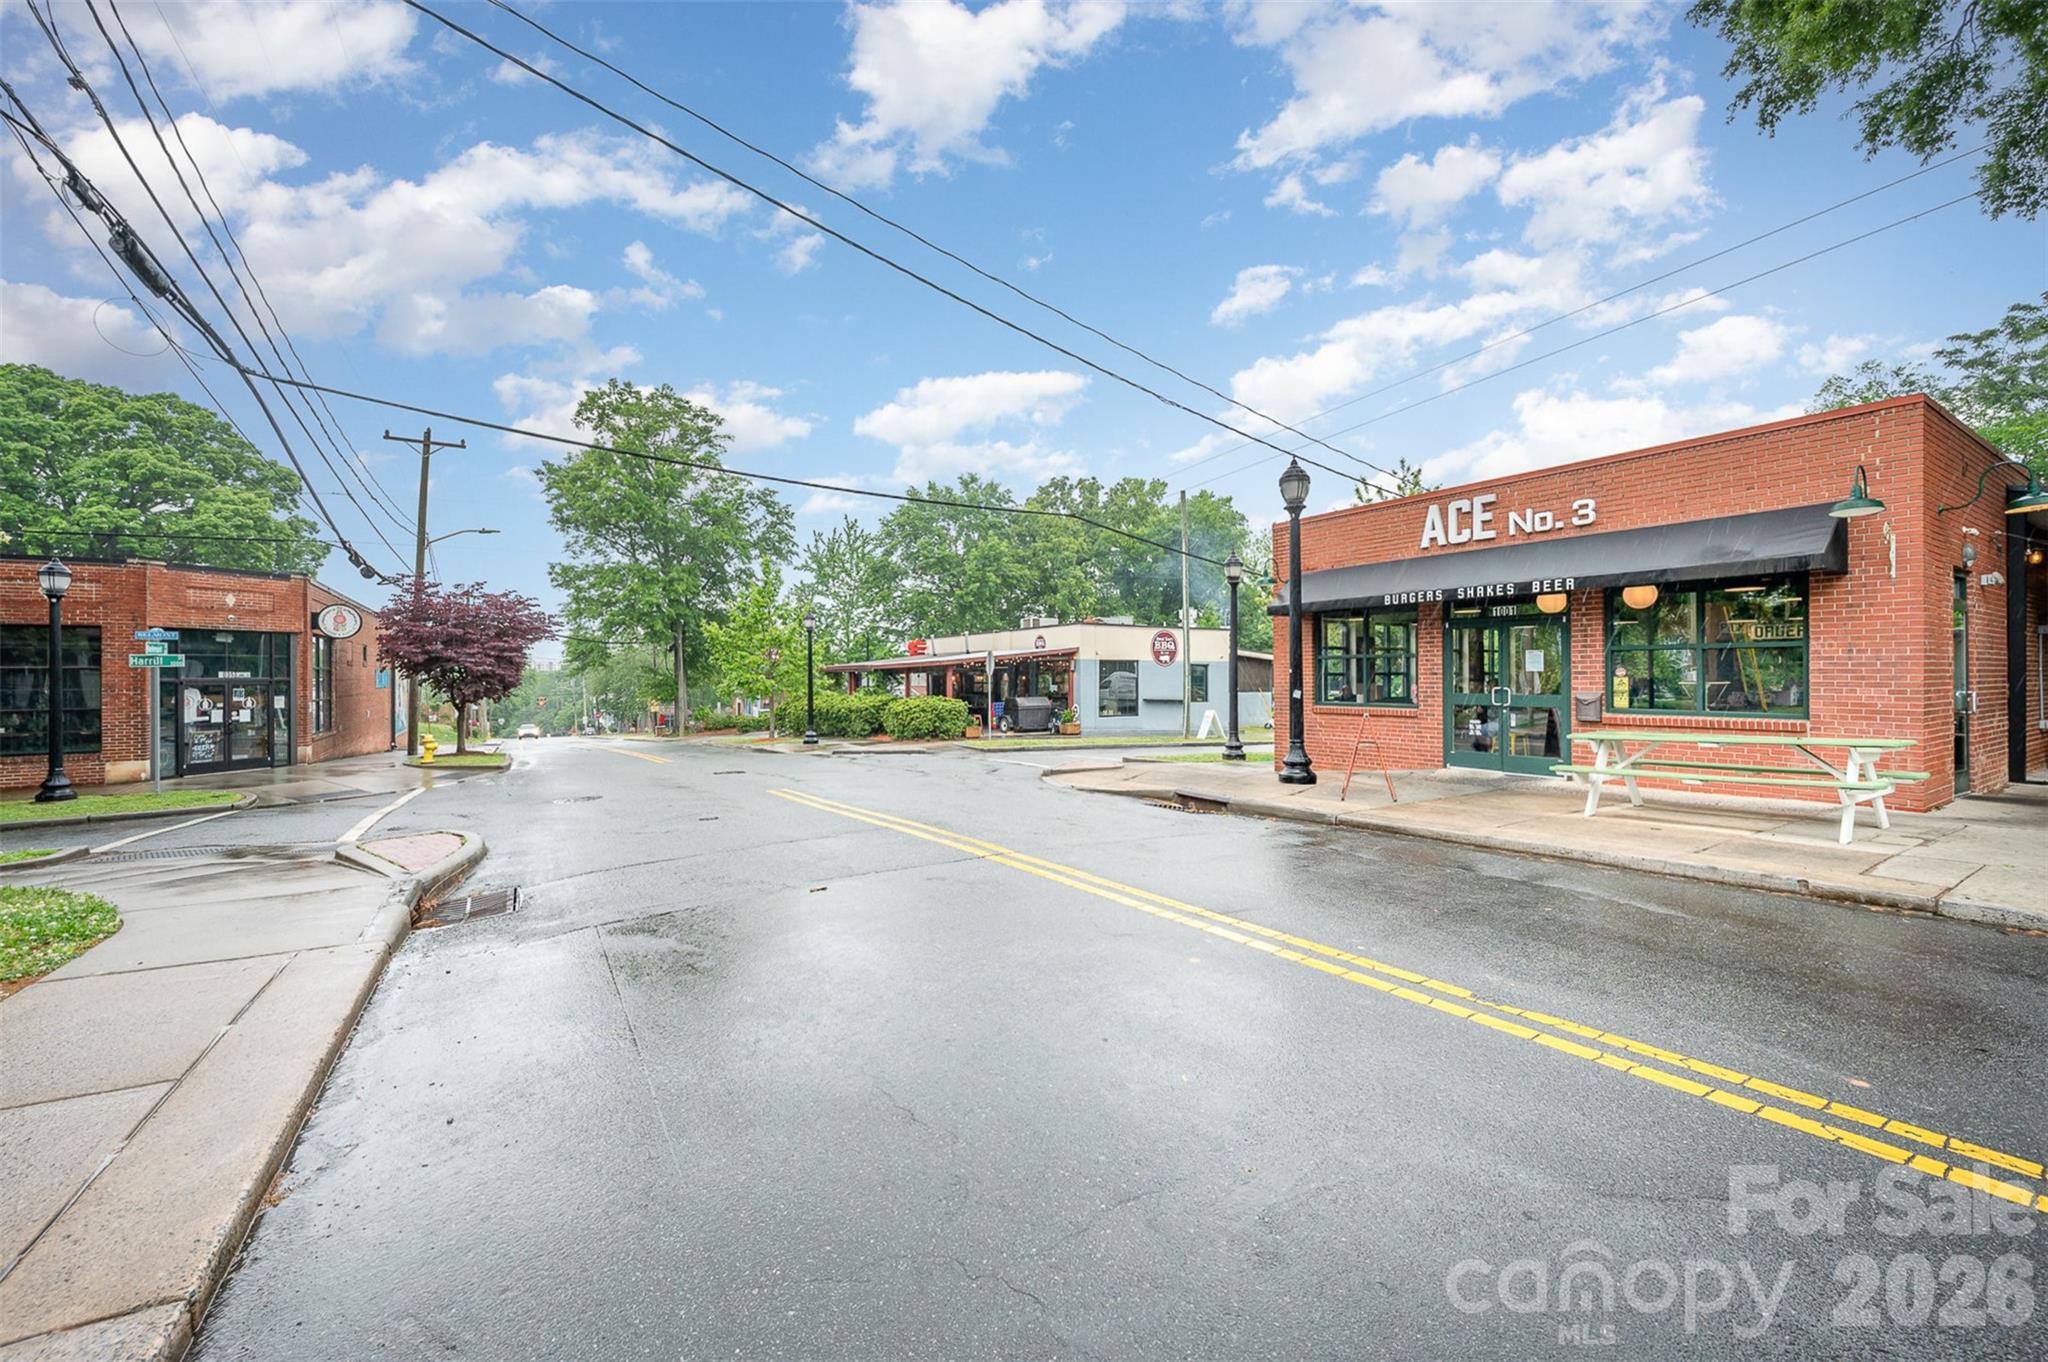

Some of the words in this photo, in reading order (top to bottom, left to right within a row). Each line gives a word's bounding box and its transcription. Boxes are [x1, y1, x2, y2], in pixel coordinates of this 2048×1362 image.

[1420, 493, 1497, 549] ACE
[1508, 508, 1565, 536] No.
[1571, 498, 1597, 526] 3
[1384, 589, 1444, 606] BURGERS
[1457, 583, 1515, 599] SHAKES
[1532, 577, 1575, 593] BEER
[1154, 640, 1175, 650] BBQ
[131, 656, 163, 666] Harrill
